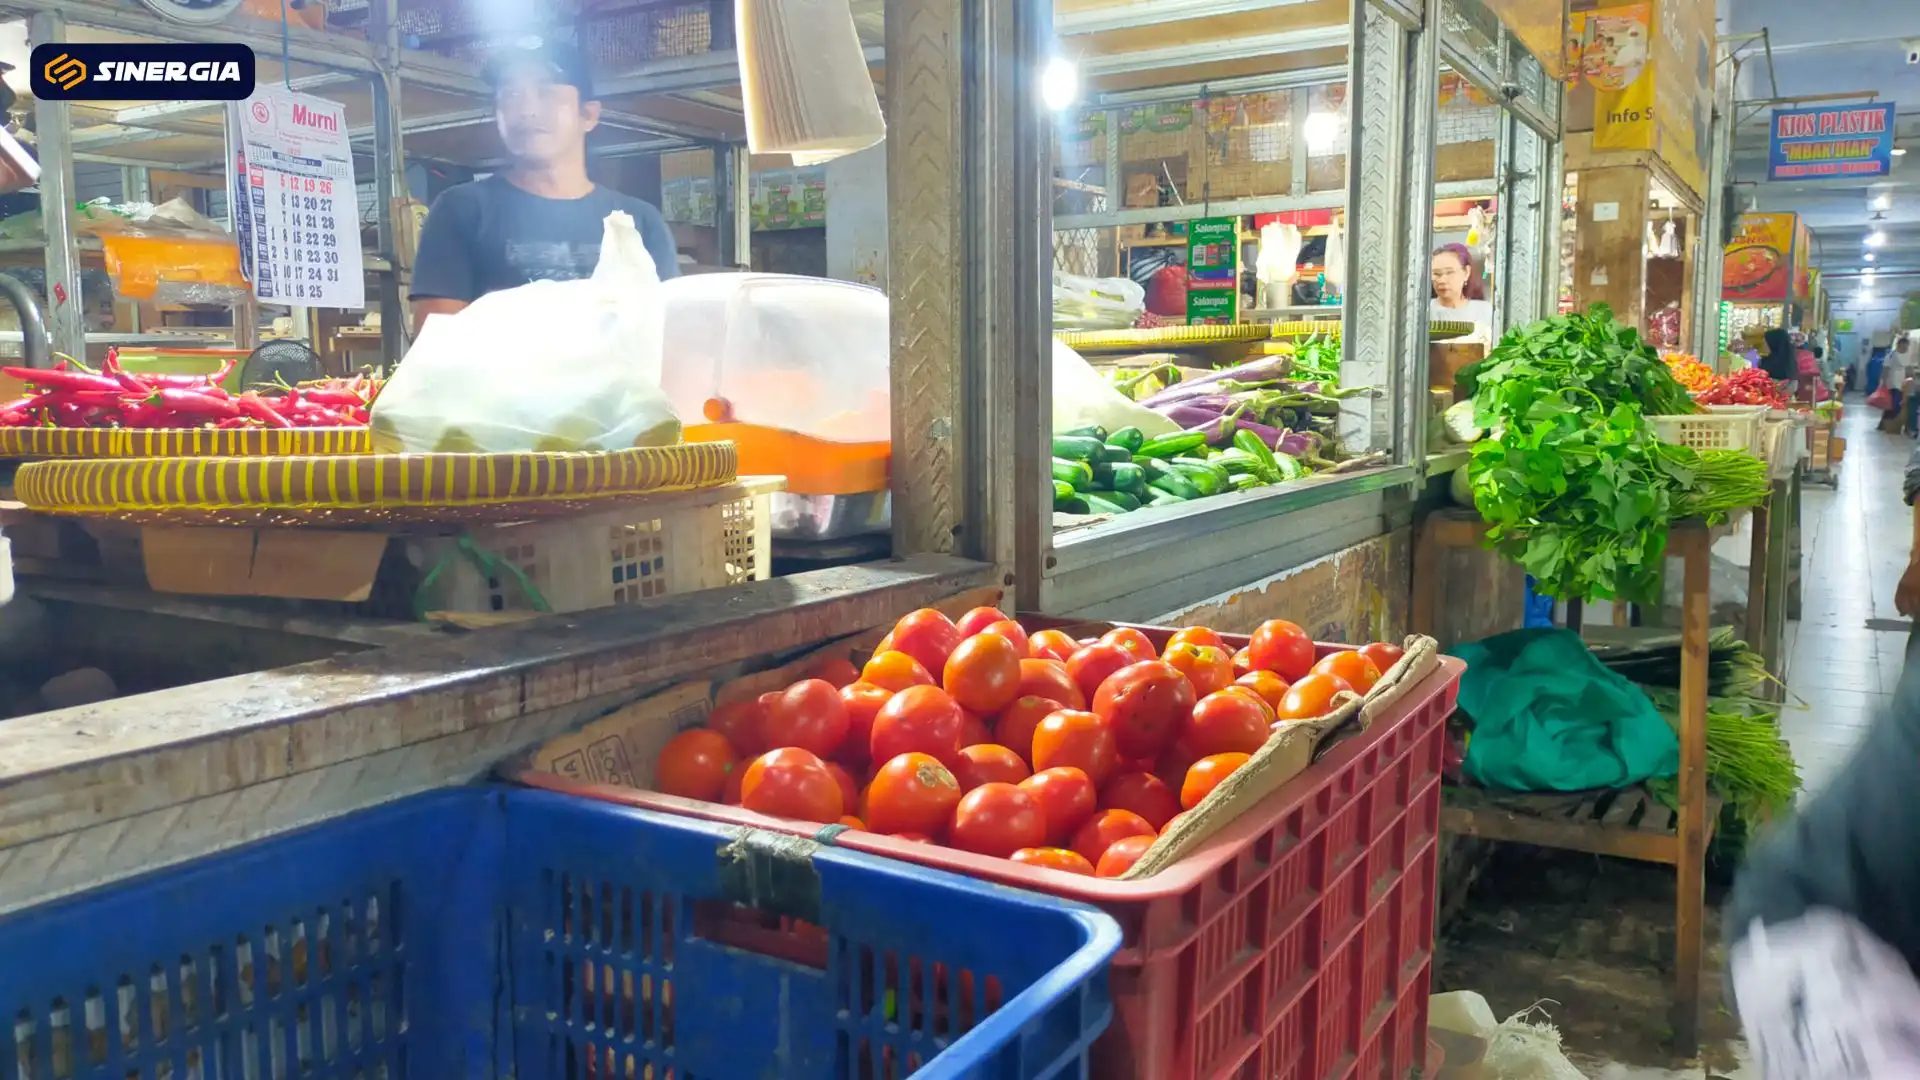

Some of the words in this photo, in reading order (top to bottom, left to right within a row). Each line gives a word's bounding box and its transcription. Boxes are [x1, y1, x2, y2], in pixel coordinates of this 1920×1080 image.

[1606, 108, 1640, 125] Info
[1777, 113, 1815, 138] KIOS
[1819, 109, 1886, 136] PLASTIK
[280, 174, 285, 187] 5
[290, 177, 299, 190] 12
[304, 179, 315, 192] 19
[320, 181, 332, 194] 26
[282, 193, 286, 206] 6
[292, 194, 300, 208] 13
[304, 196, 317, 210] 20
[320, 200, 332, 212] 27
[282, 210, 286, 223] 7
[292, 213, 301, 227] 14
[306, 215, 317, 228] 21
[322, 216, 334, 230] 28
[272, 227, 275, 240] 1
[283, 228, 288, 242] 8
[293, 232, 302, 244] 15
[306, 232, 319, 246] 22
[322, 234, 336, 247] 29
[272, 246, 277, 258] 2
[284, 247, 288, 260] 9
[294, 248, 302, 262] 16
[307, 250, 320, 264] 23
[324, 251, 338, 264] 30
[273, 264, 278, 276] 3
[284, 265, 291, 278] 10
[295, 266, 302, 280] 17
[308, 268, 322, 281] 24
[328, 268, 338, 282] 31
[275, 282, 280, 296] 4
[285, 283, 292, 296] 11
[296, 284, 304, 298] 18
[309, 285, 322, 298] 25
